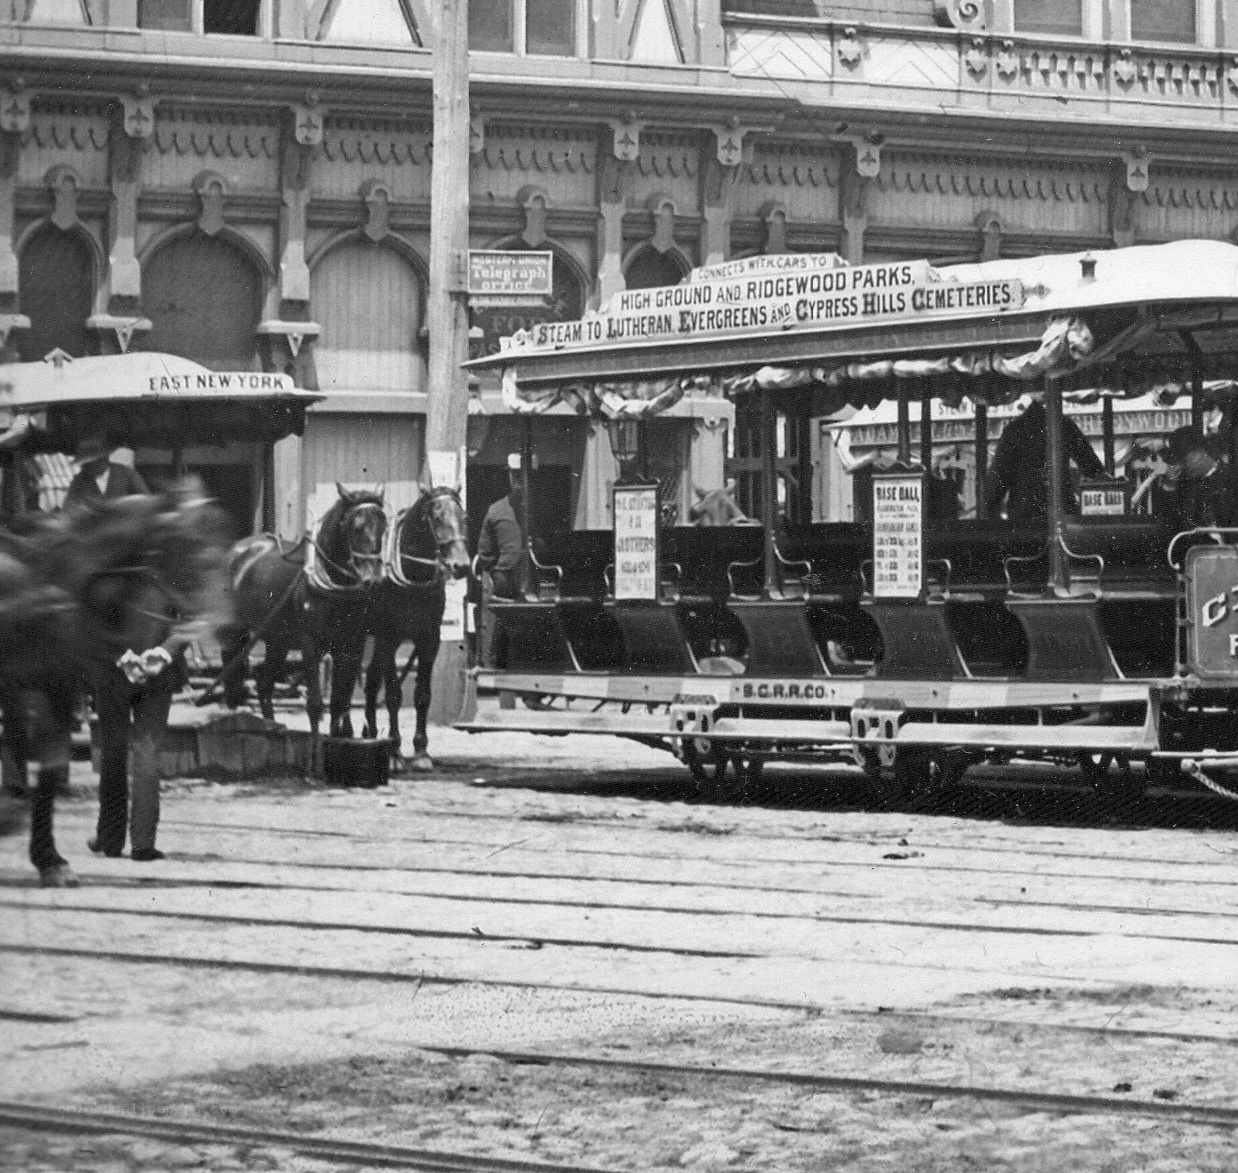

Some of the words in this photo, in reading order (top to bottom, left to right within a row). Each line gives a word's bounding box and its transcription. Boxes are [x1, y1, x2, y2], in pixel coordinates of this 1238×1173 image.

[471, 264, 546, 283] Telegraph
[698, 262, 746, 280] CONNECTS
[776, 256, 808, 269] CARS
[811, 256, 827, 268] TO
[481, 281, 532, 291] OFFICE
[621, 292, 651, 311] HIGH
[655, 285, 711, 308] GROUND
[747, 272, 847, 299] RIDGEWOOD
[537, 323, 582, 345] STEAM
[587, 320, 602, 340] TO
[678, 306, 767, 333] EVERGREENS
[770, 302, 792, 323] AND
[795, 295, 858, 321] CYPRESS
[861, 291, 906, 315] HILLS
[149, 375, 191, 391] EAST
[197, 374, 232, 388] NEW
[238, 375, 284, 389] YORK
[876, 486, 897, 501] BASE
